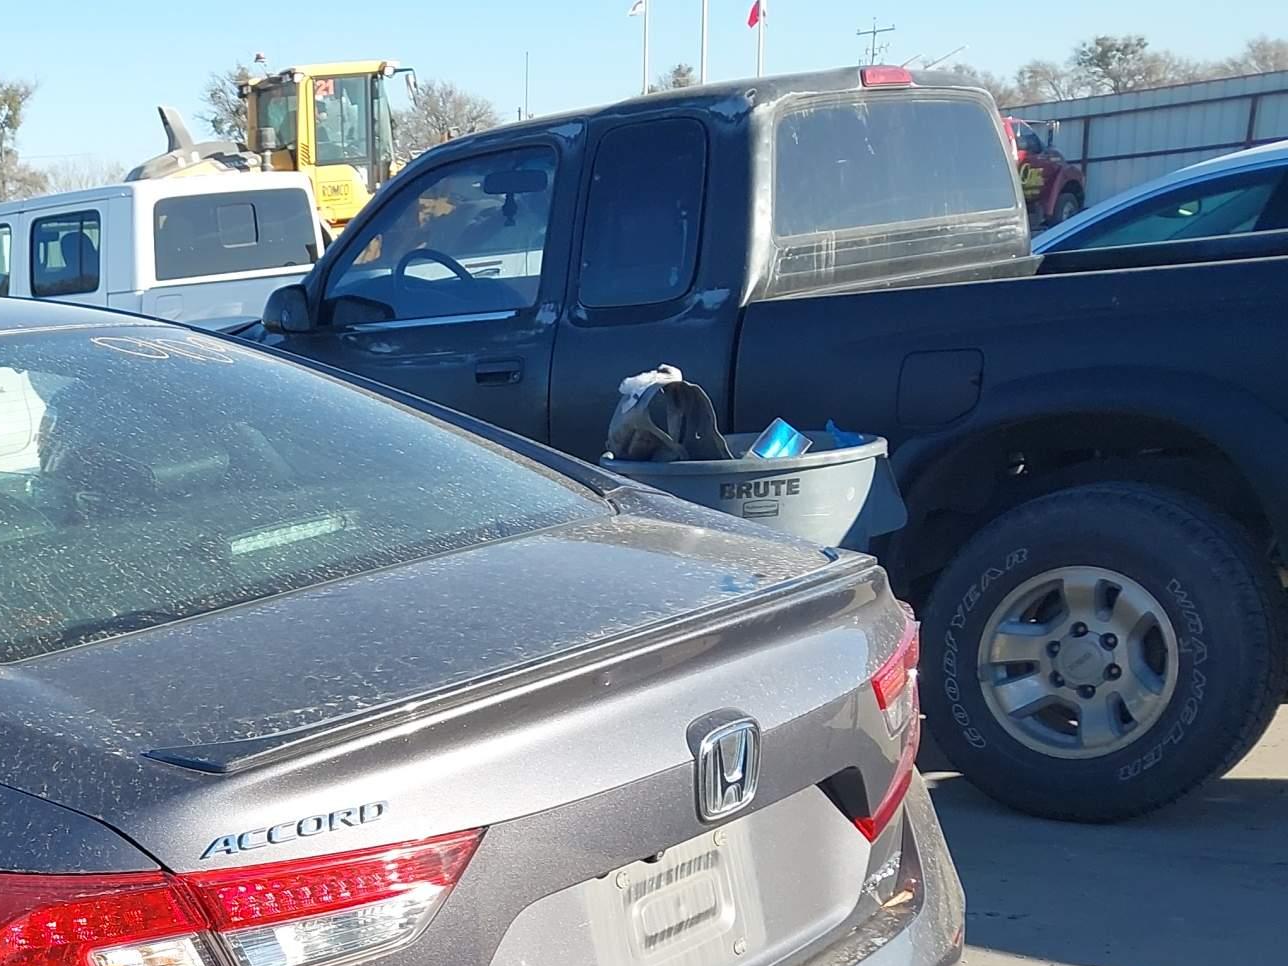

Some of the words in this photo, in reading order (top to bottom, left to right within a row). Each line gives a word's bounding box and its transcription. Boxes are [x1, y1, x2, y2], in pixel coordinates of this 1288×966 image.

[719, 478, 800, 499] BRUTE
[943, 548, 1028, 748] GOODYEAR
[1119, 578, 1208, 780] WRANGLER
[199, 800, 389, 860] ACCORD
